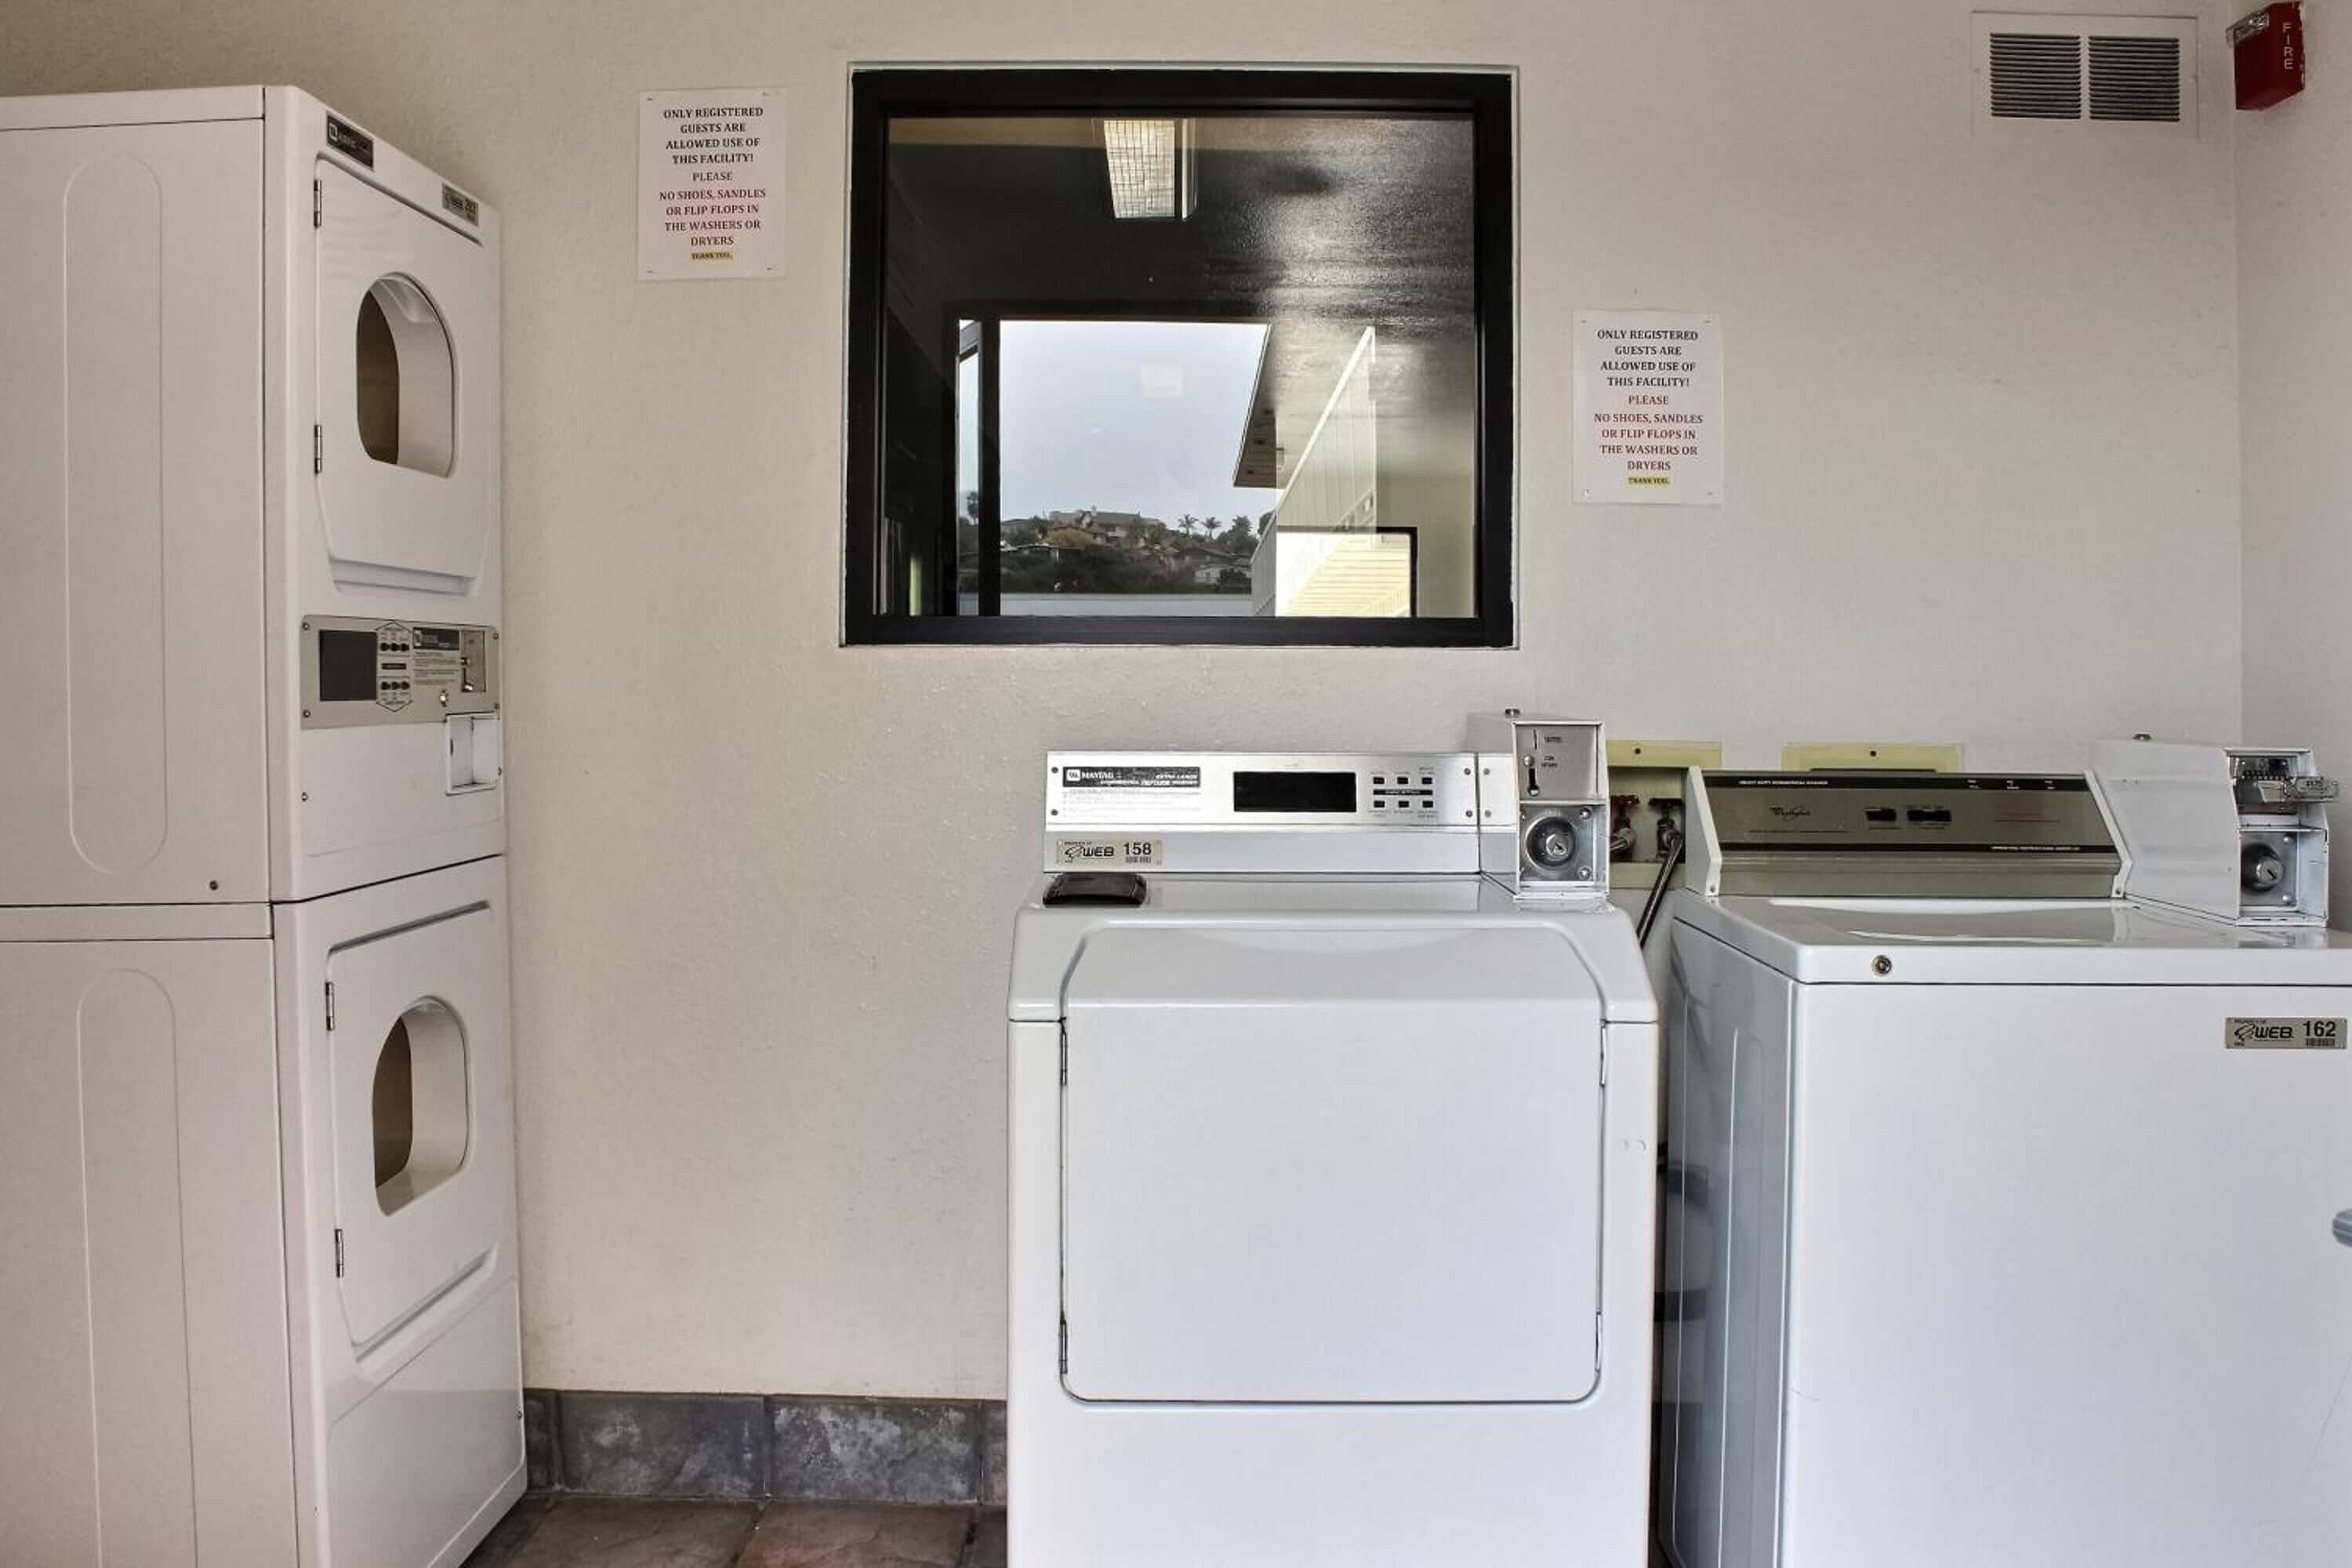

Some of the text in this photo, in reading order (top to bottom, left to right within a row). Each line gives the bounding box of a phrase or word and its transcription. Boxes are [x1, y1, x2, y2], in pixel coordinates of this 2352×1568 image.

[2283, 23, 2293, 69] FIRE
[663, 107, 763, 118] ONLY REGISTERED
[681, 123, 746, 133] GUESTS ARE
[666, 138, 760, 149] ALLOWED USE OF
[673, 154, 753, 164] THIS FACILITY!
[693, 172, 732, 181] PLEASE
[659, 189, 766, 201] NO SHOES, SANDLES
[666, 205, 758, 216] OR FLIP FLOPS IN
[665, 220, 760, 230] THE WASHERS OR
[691, 237, 734, 245] DRYERS
[1597, 331, 1698, 340] ONLY REGISTERED
[1615, 347, 1682, 355] GUESTS ARE
[1658, 362, 1679, 371] USE
[1636, 378, 1690, 387] FACILITY!
[1628, 396, 1668, 405] PLEASE
[1594, 414, 1703, 424] NO SHOES, SANDLES
[1602, 430, 1617, 438] OR
[1621, 430, 1644, 438] FLIP
[1647, 430, 1681, 439] FLOPS
[1625, 446, 1679, 455] WASHERS
[1628, 461, 1671, 470] DRYERS
[1083, 847, 1114, 856] WEB
[1124, 842, 1152, 855] 158
[2254, 1026, 2293, 1038] WEB
[2303, 1021, 2336, 1036] 162
